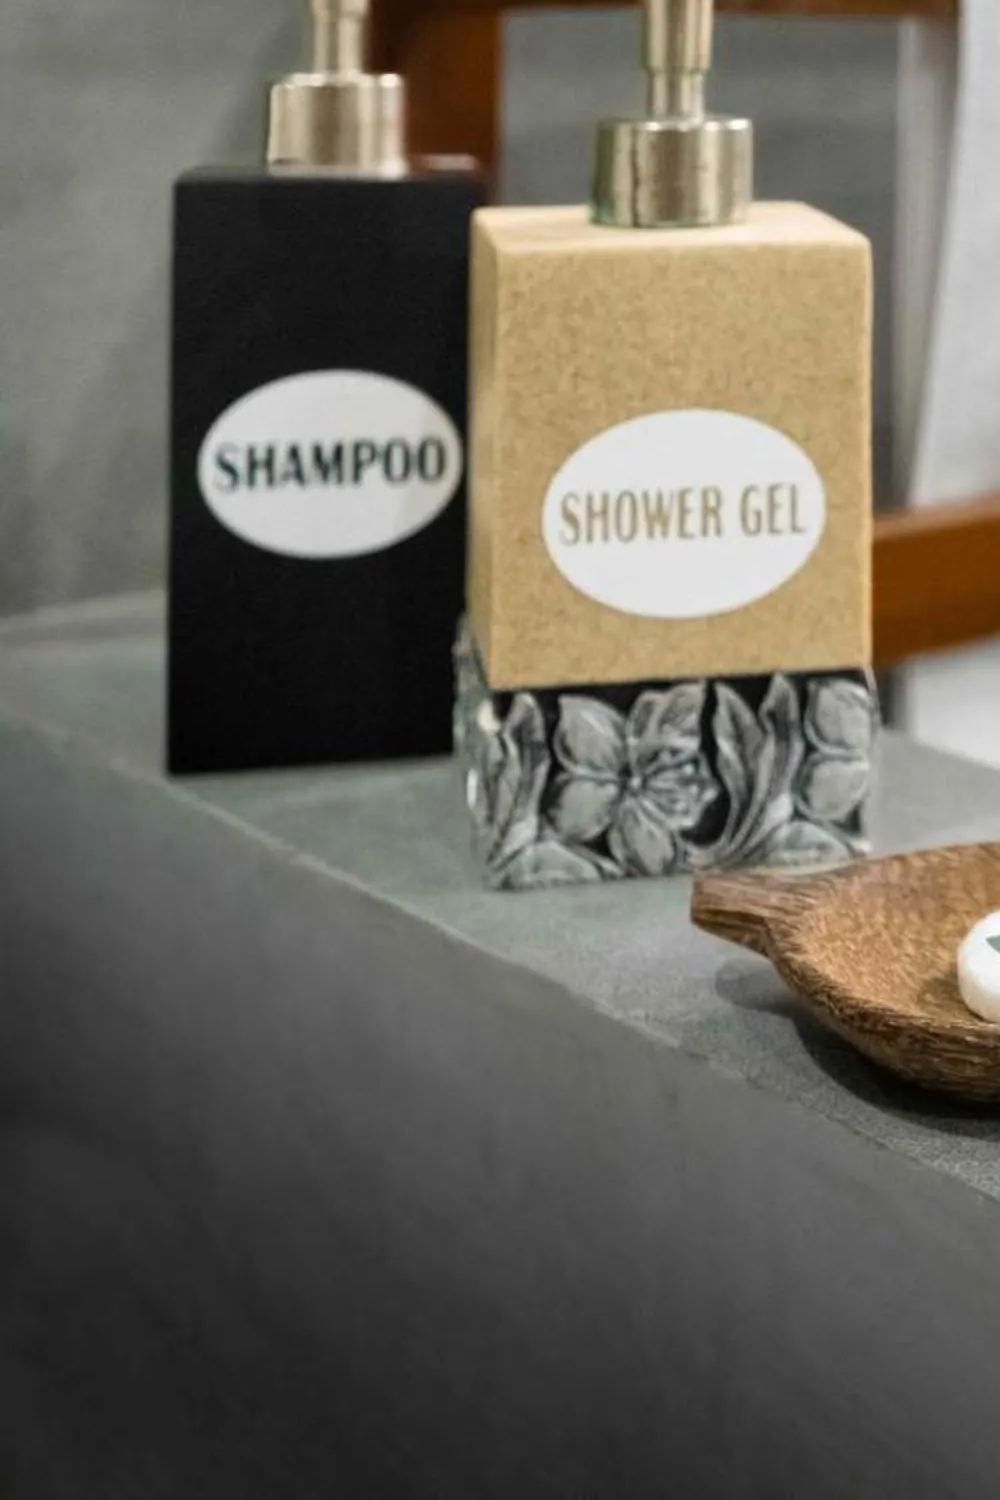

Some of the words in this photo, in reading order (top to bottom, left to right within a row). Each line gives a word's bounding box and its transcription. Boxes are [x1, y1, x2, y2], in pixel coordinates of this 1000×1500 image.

[213, 435, 447, 493] SHAMPOO
[557, 486, 724, 547] SHOWER
[739, 482, 806, 538] GEL
